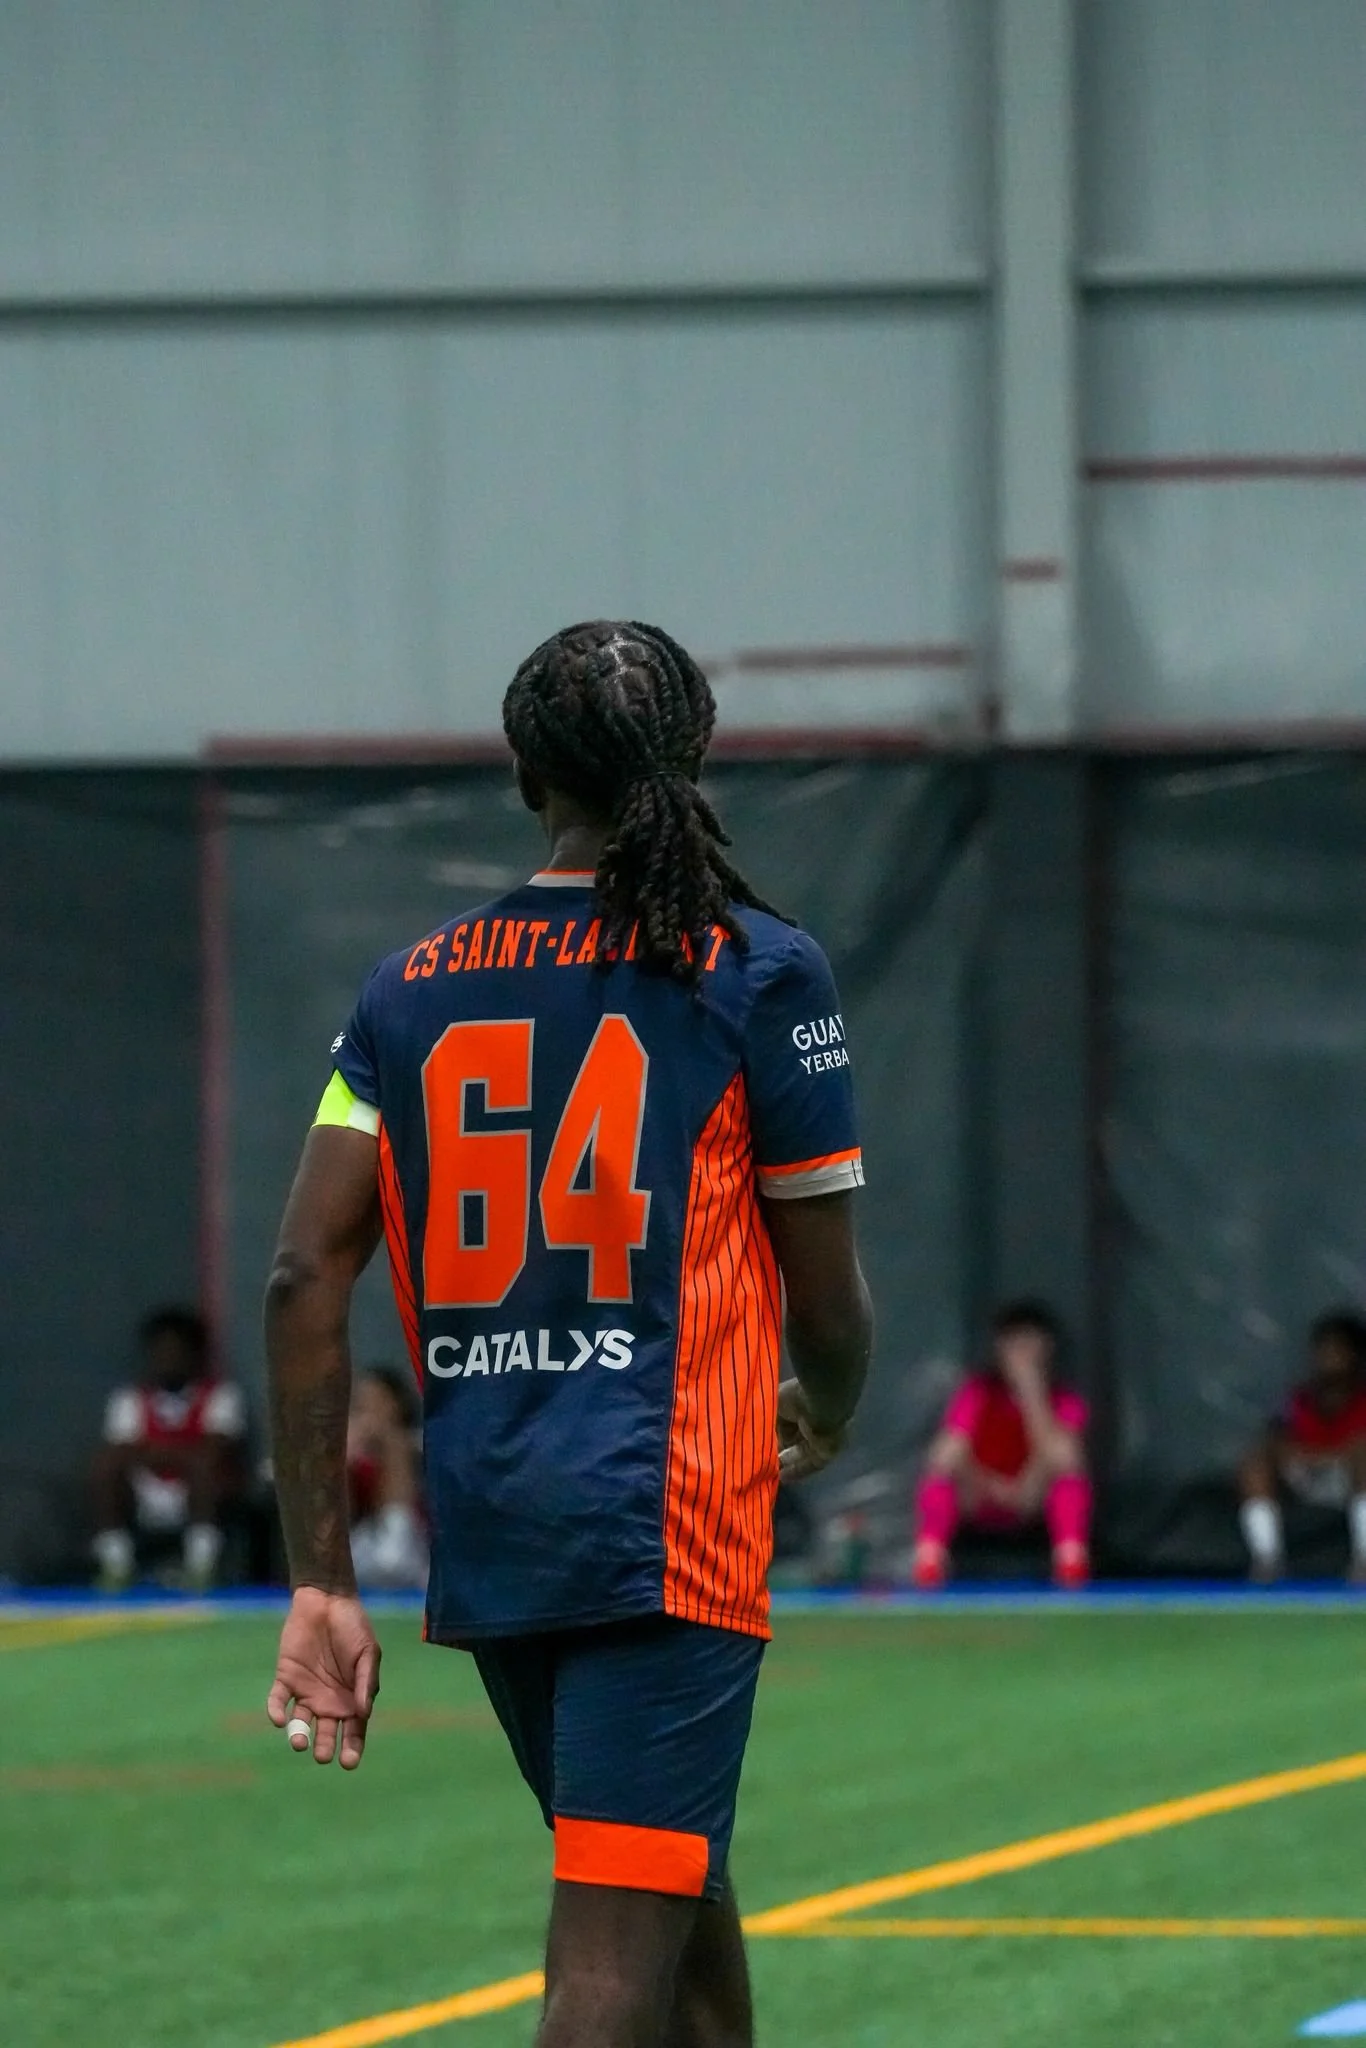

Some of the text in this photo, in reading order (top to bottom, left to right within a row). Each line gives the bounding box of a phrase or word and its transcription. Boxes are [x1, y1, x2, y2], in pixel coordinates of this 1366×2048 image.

[404, 919, 732, 982] CS SAINT-LAT
[799, 1047, 850, 1075] YERBA
[421, 1013, 652, 1310] 64
[427, 1328, 636, 1379] CATALYS
